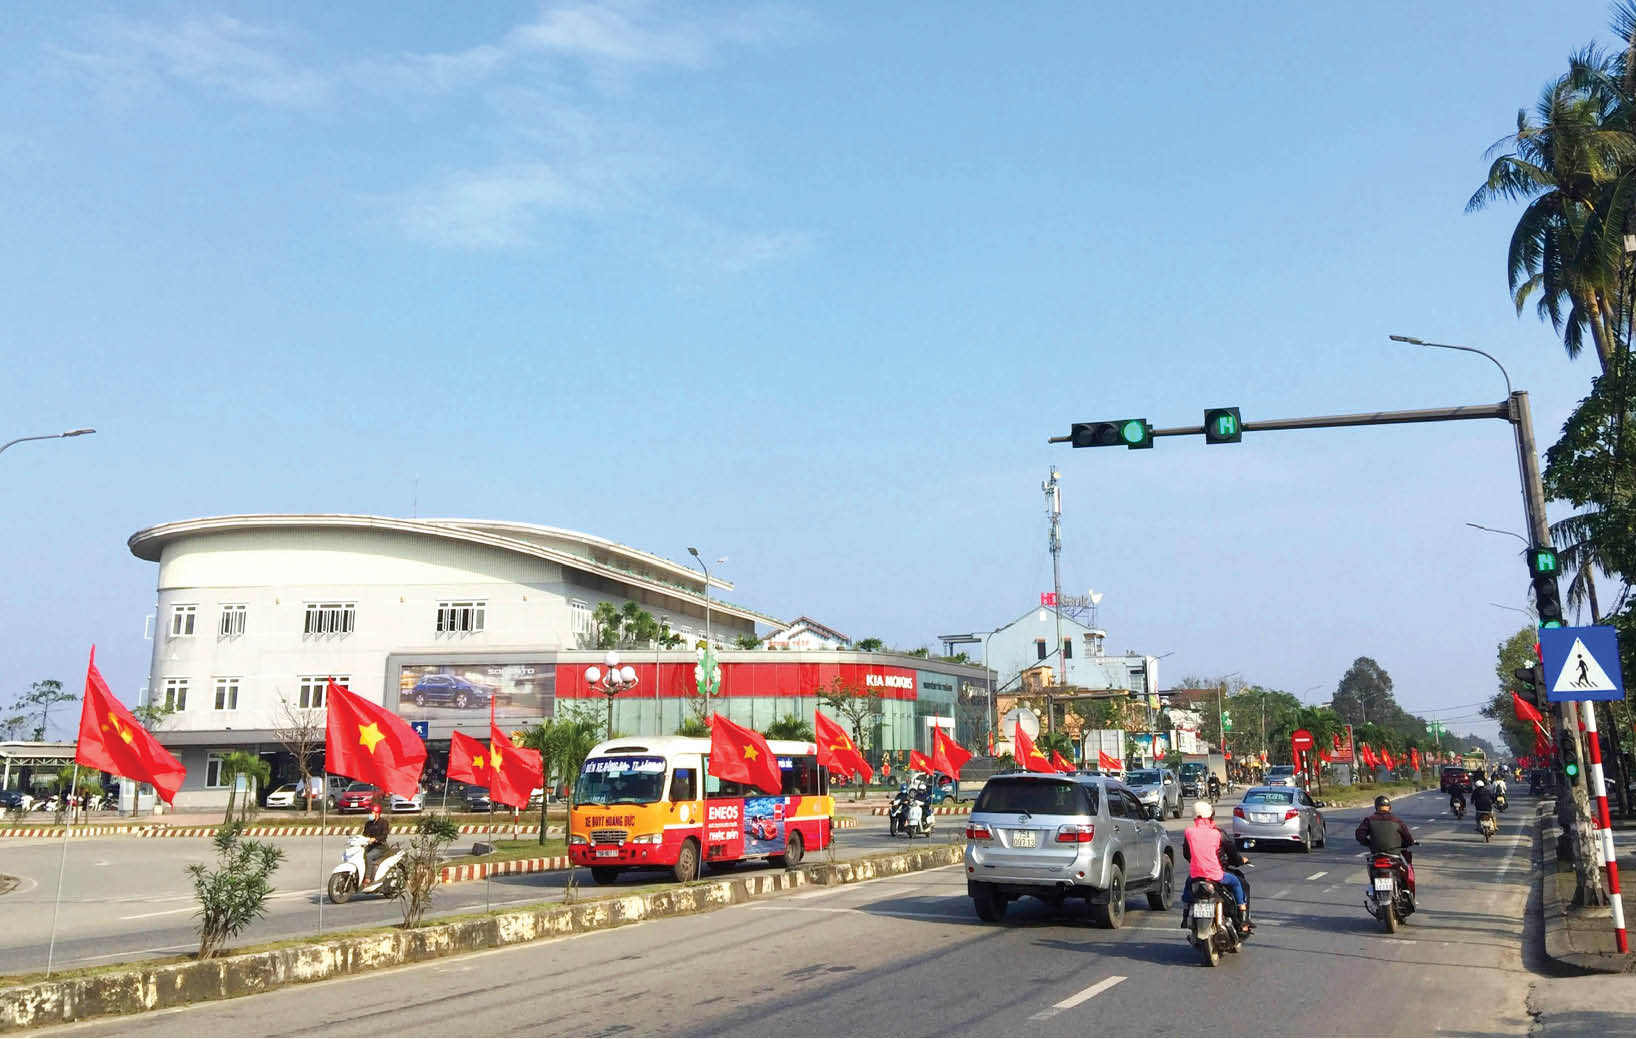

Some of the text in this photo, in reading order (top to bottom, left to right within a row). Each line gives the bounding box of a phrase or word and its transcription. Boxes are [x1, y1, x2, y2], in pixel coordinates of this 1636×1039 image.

[866, 675, 884, 687] KIA
[885, 676, 912, 689] MOTORS
[708, 805, 739, 820] ENEOS
